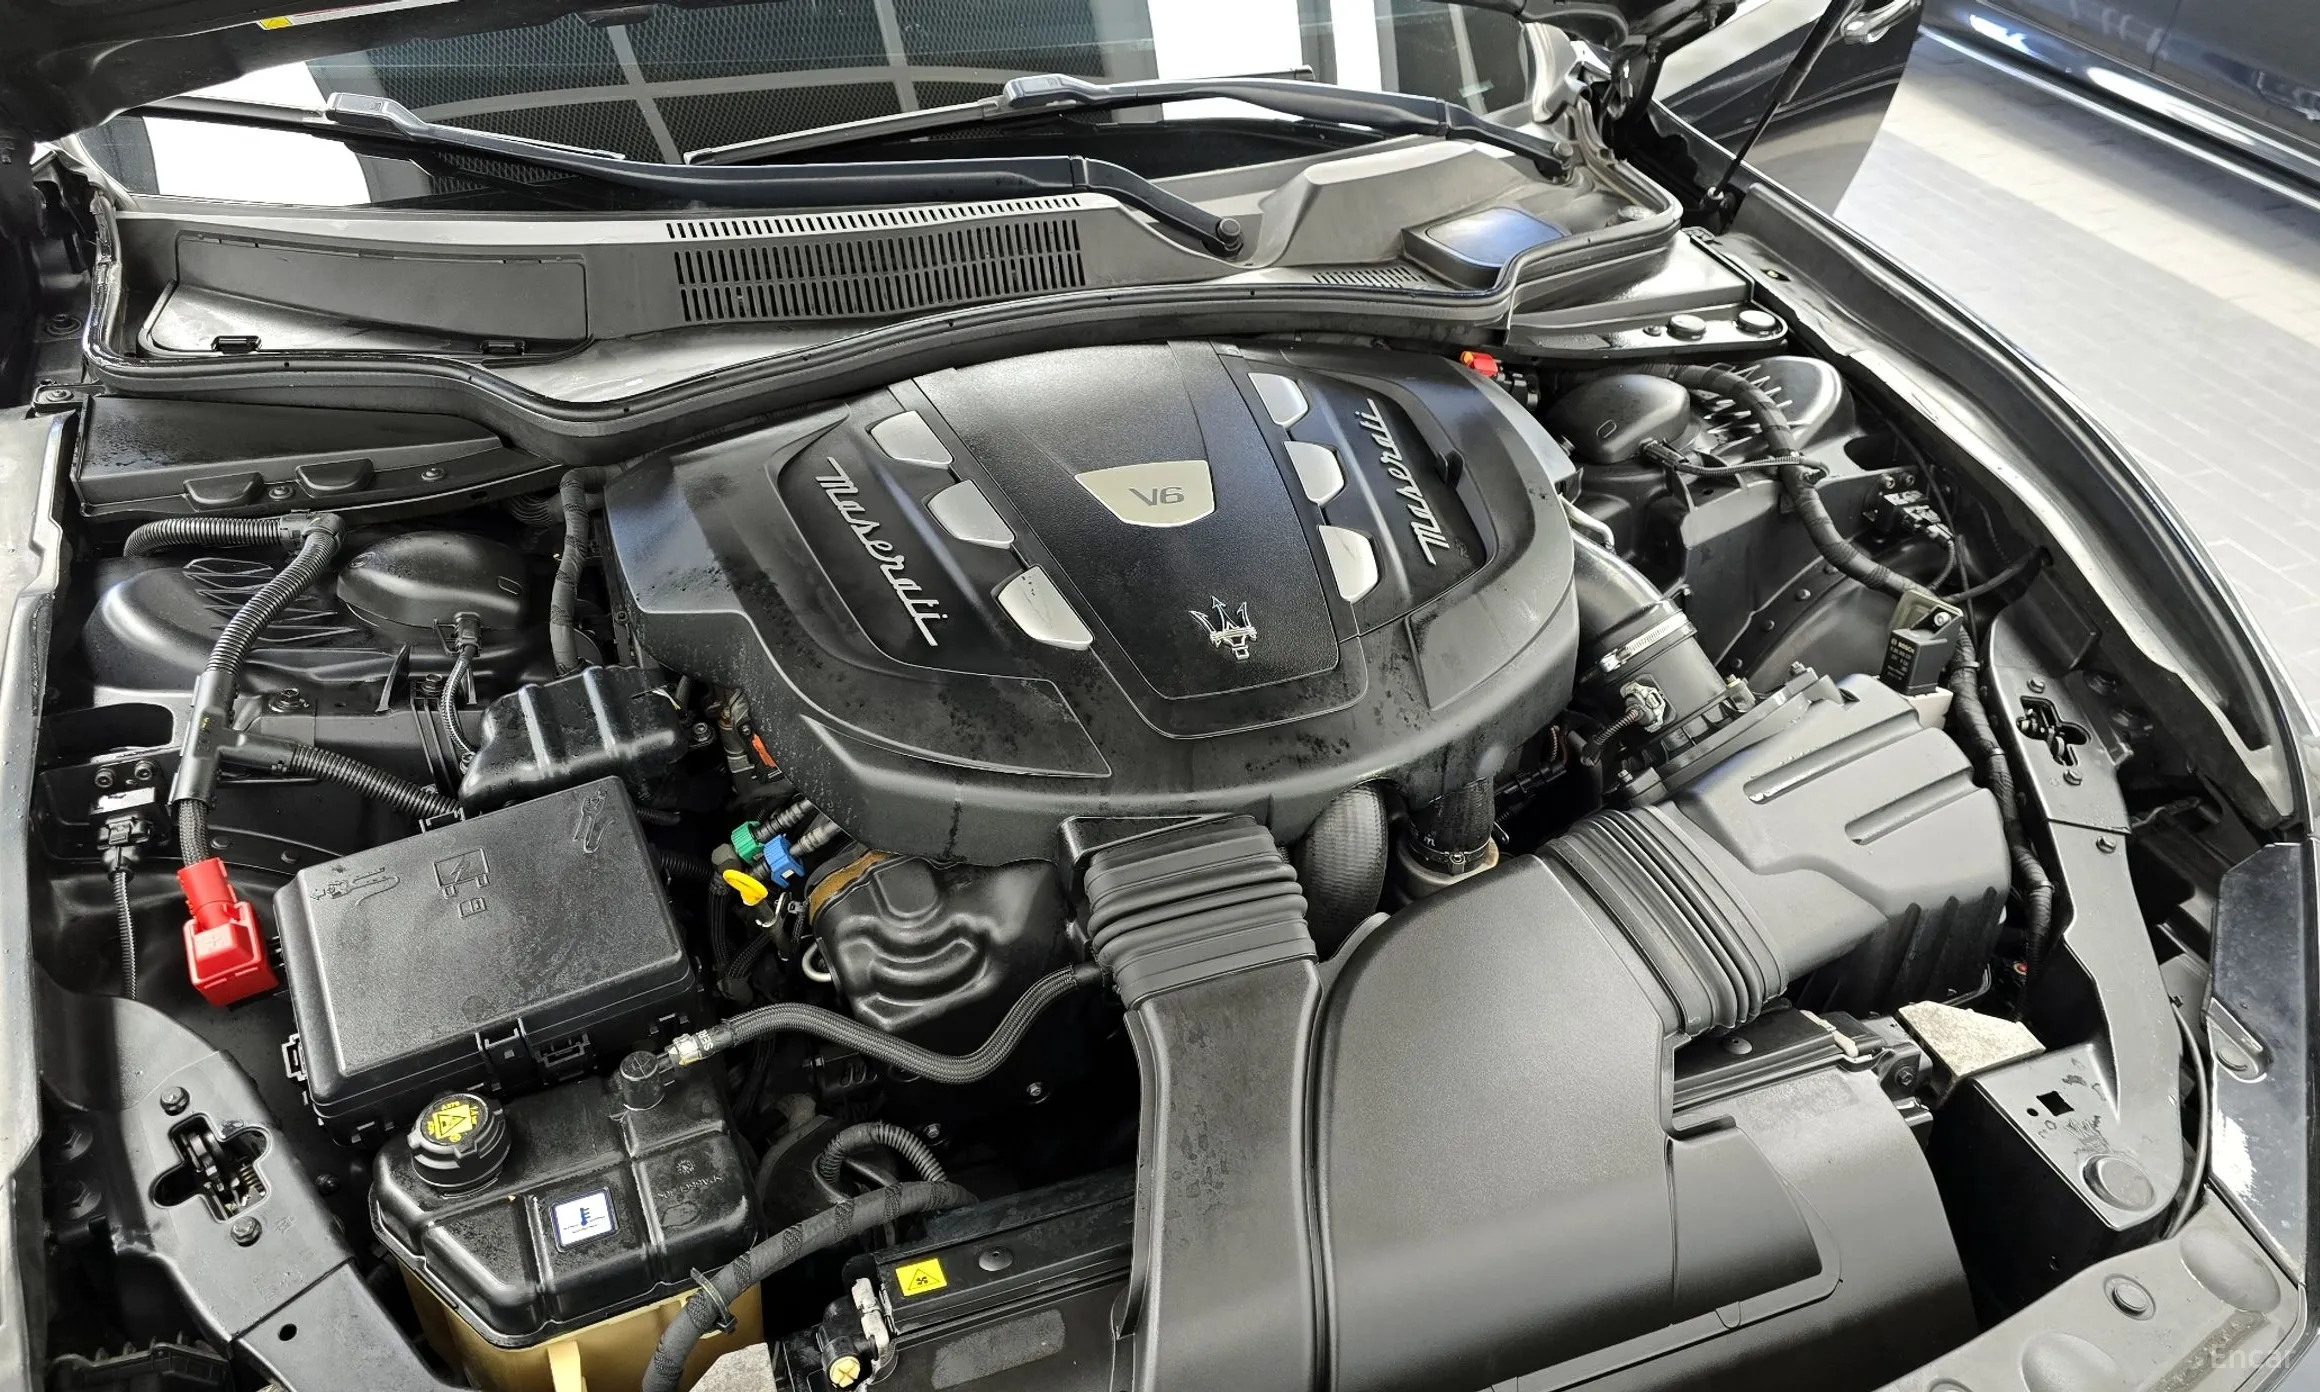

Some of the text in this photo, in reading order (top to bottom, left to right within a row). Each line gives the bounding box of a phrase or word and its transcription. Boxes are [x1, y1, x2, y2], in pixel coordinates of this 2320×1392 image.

[815, 456, 949, 647] Maserati
[1128, 486, 1185, 507] V6
[1354, 398, 1450, 566] Maserati
